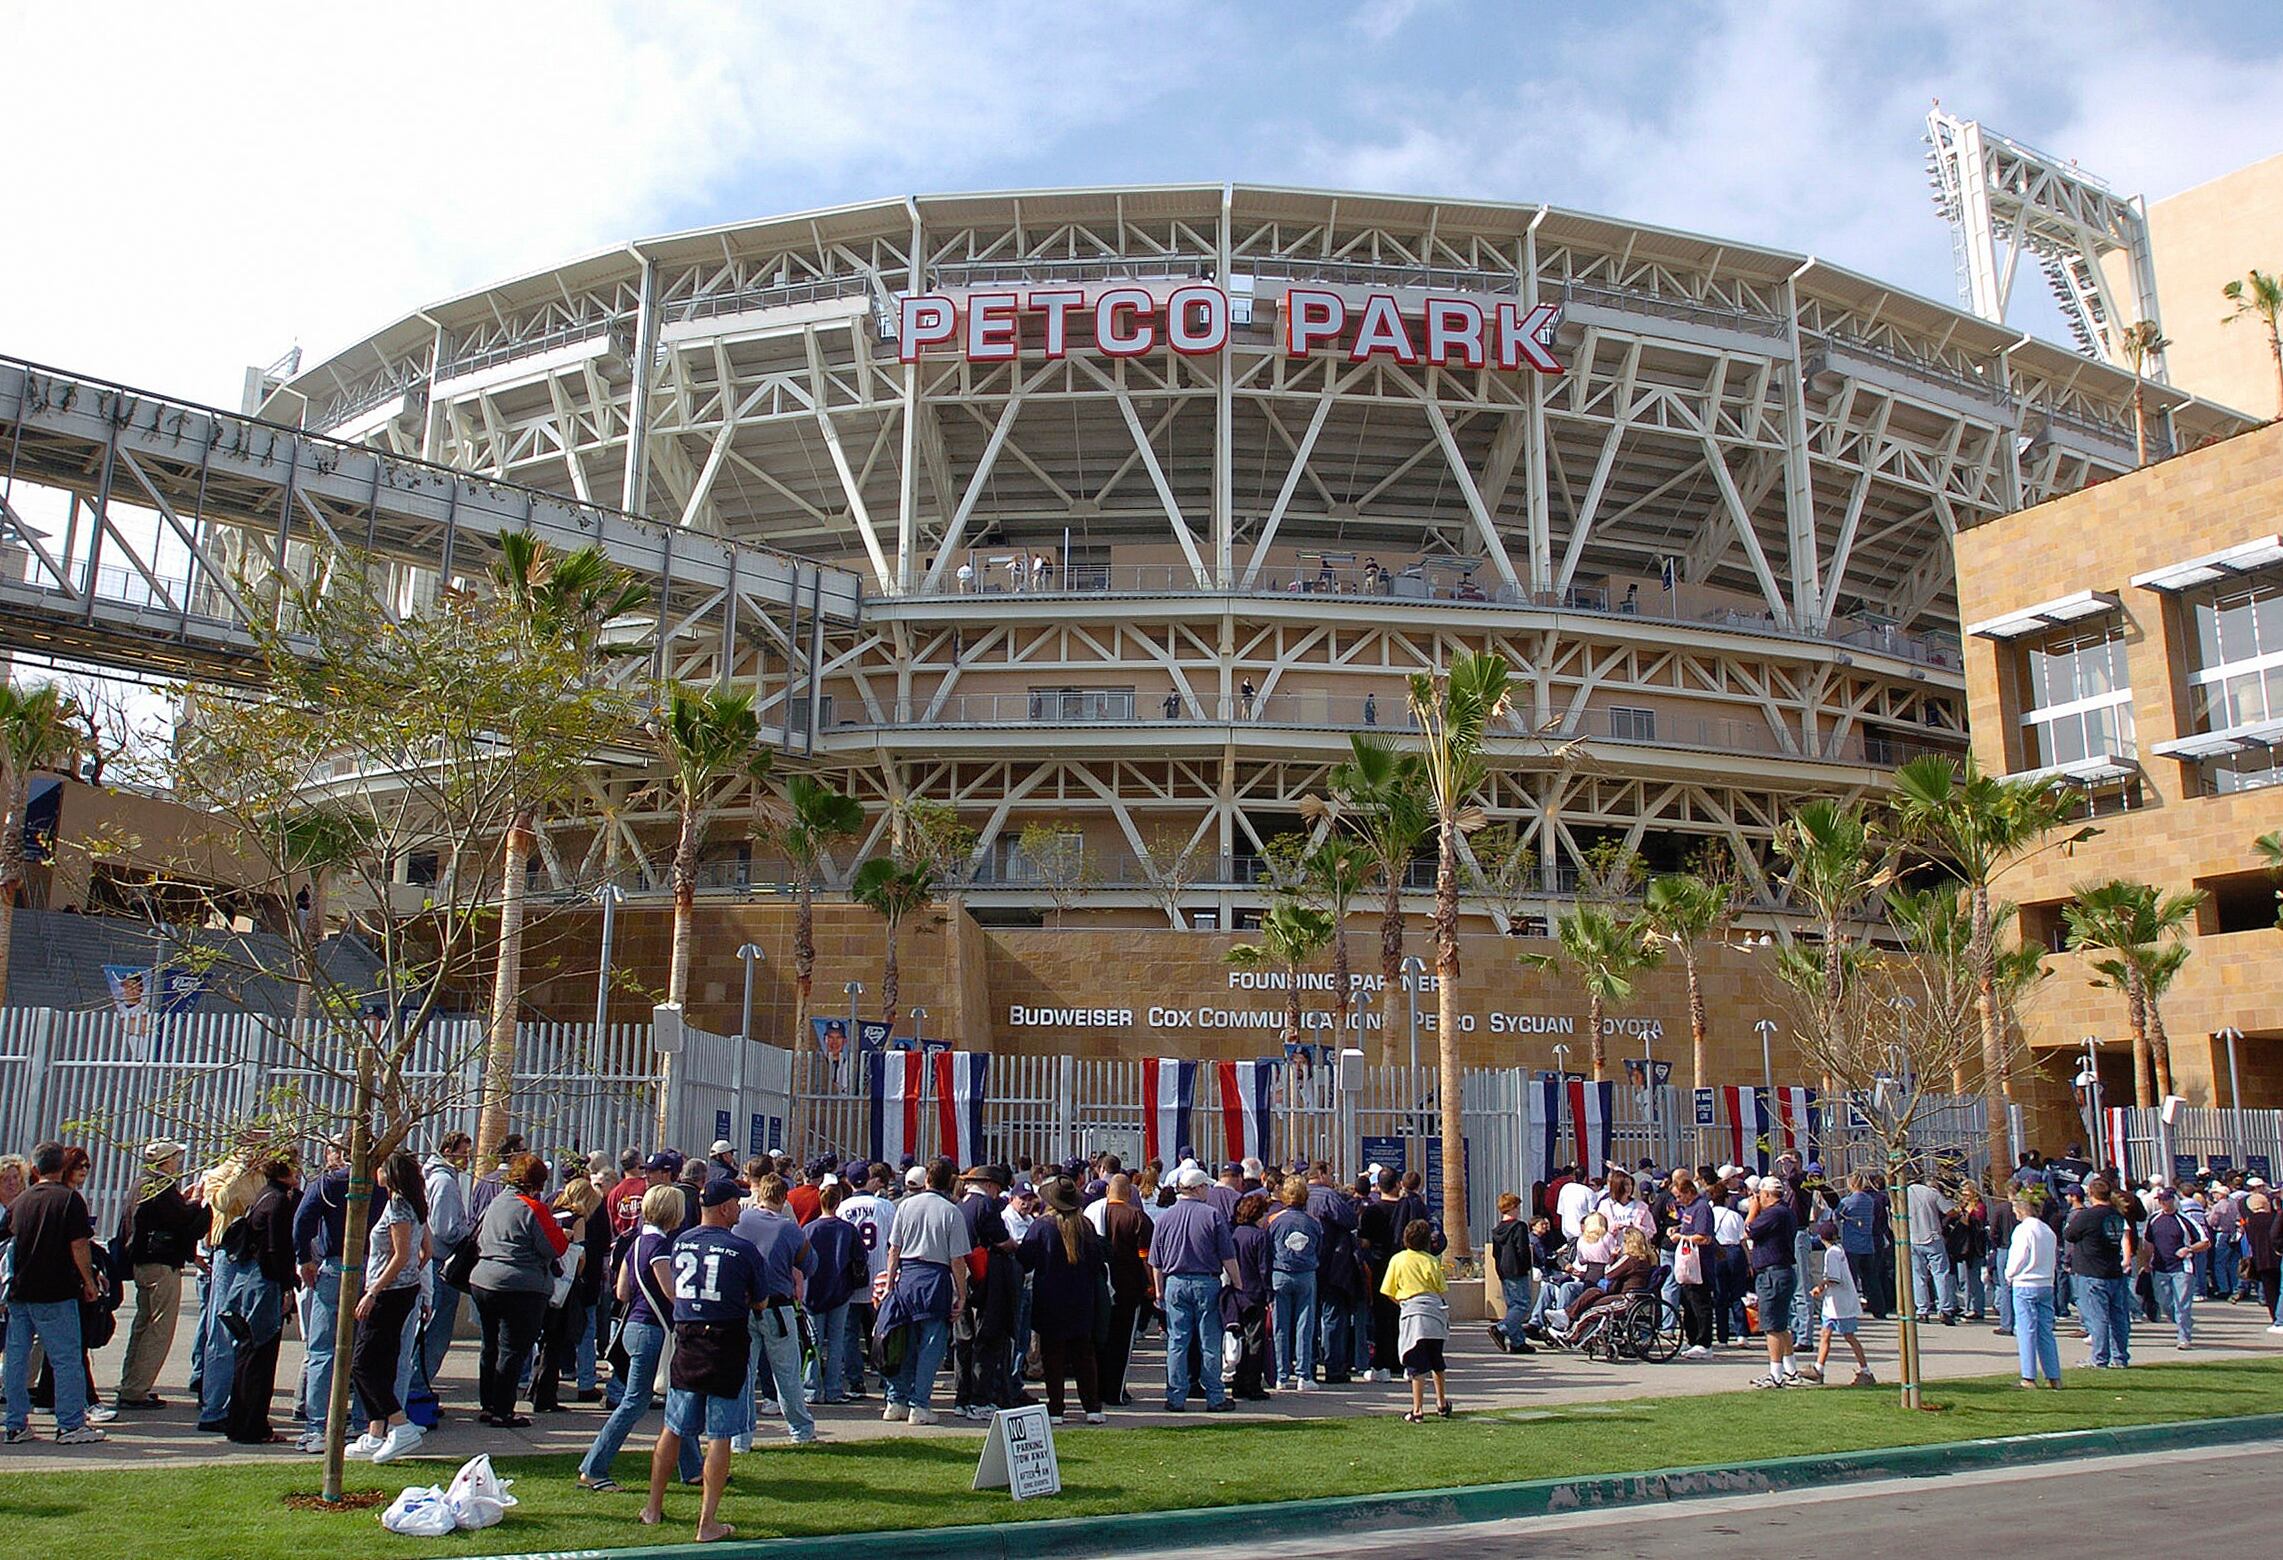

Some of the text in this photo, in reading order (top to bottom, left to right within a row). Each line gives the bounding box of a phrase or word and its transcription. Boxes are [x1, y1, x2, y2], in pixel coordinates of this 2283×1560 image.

[899, 286, 1564, 374] PETCO PARK
[1009, 1004, 1133, 1028] BUDWEISER
[1148, 1006, 1193, 1028] COX
[1490, 1012, 1574, 1034] SYCUAN
[1602, 1017, 1664, 1036] OYOTA
[845, 1206, 875, 1220] GWYNN
[675, 1251, 721, 1302] 21
[1008, 1417, 1026, 1440] NO
[1015, 1451, 1049, 1465] TOW AWAY
[1016, 1440, 1044, 1454] PARKING
